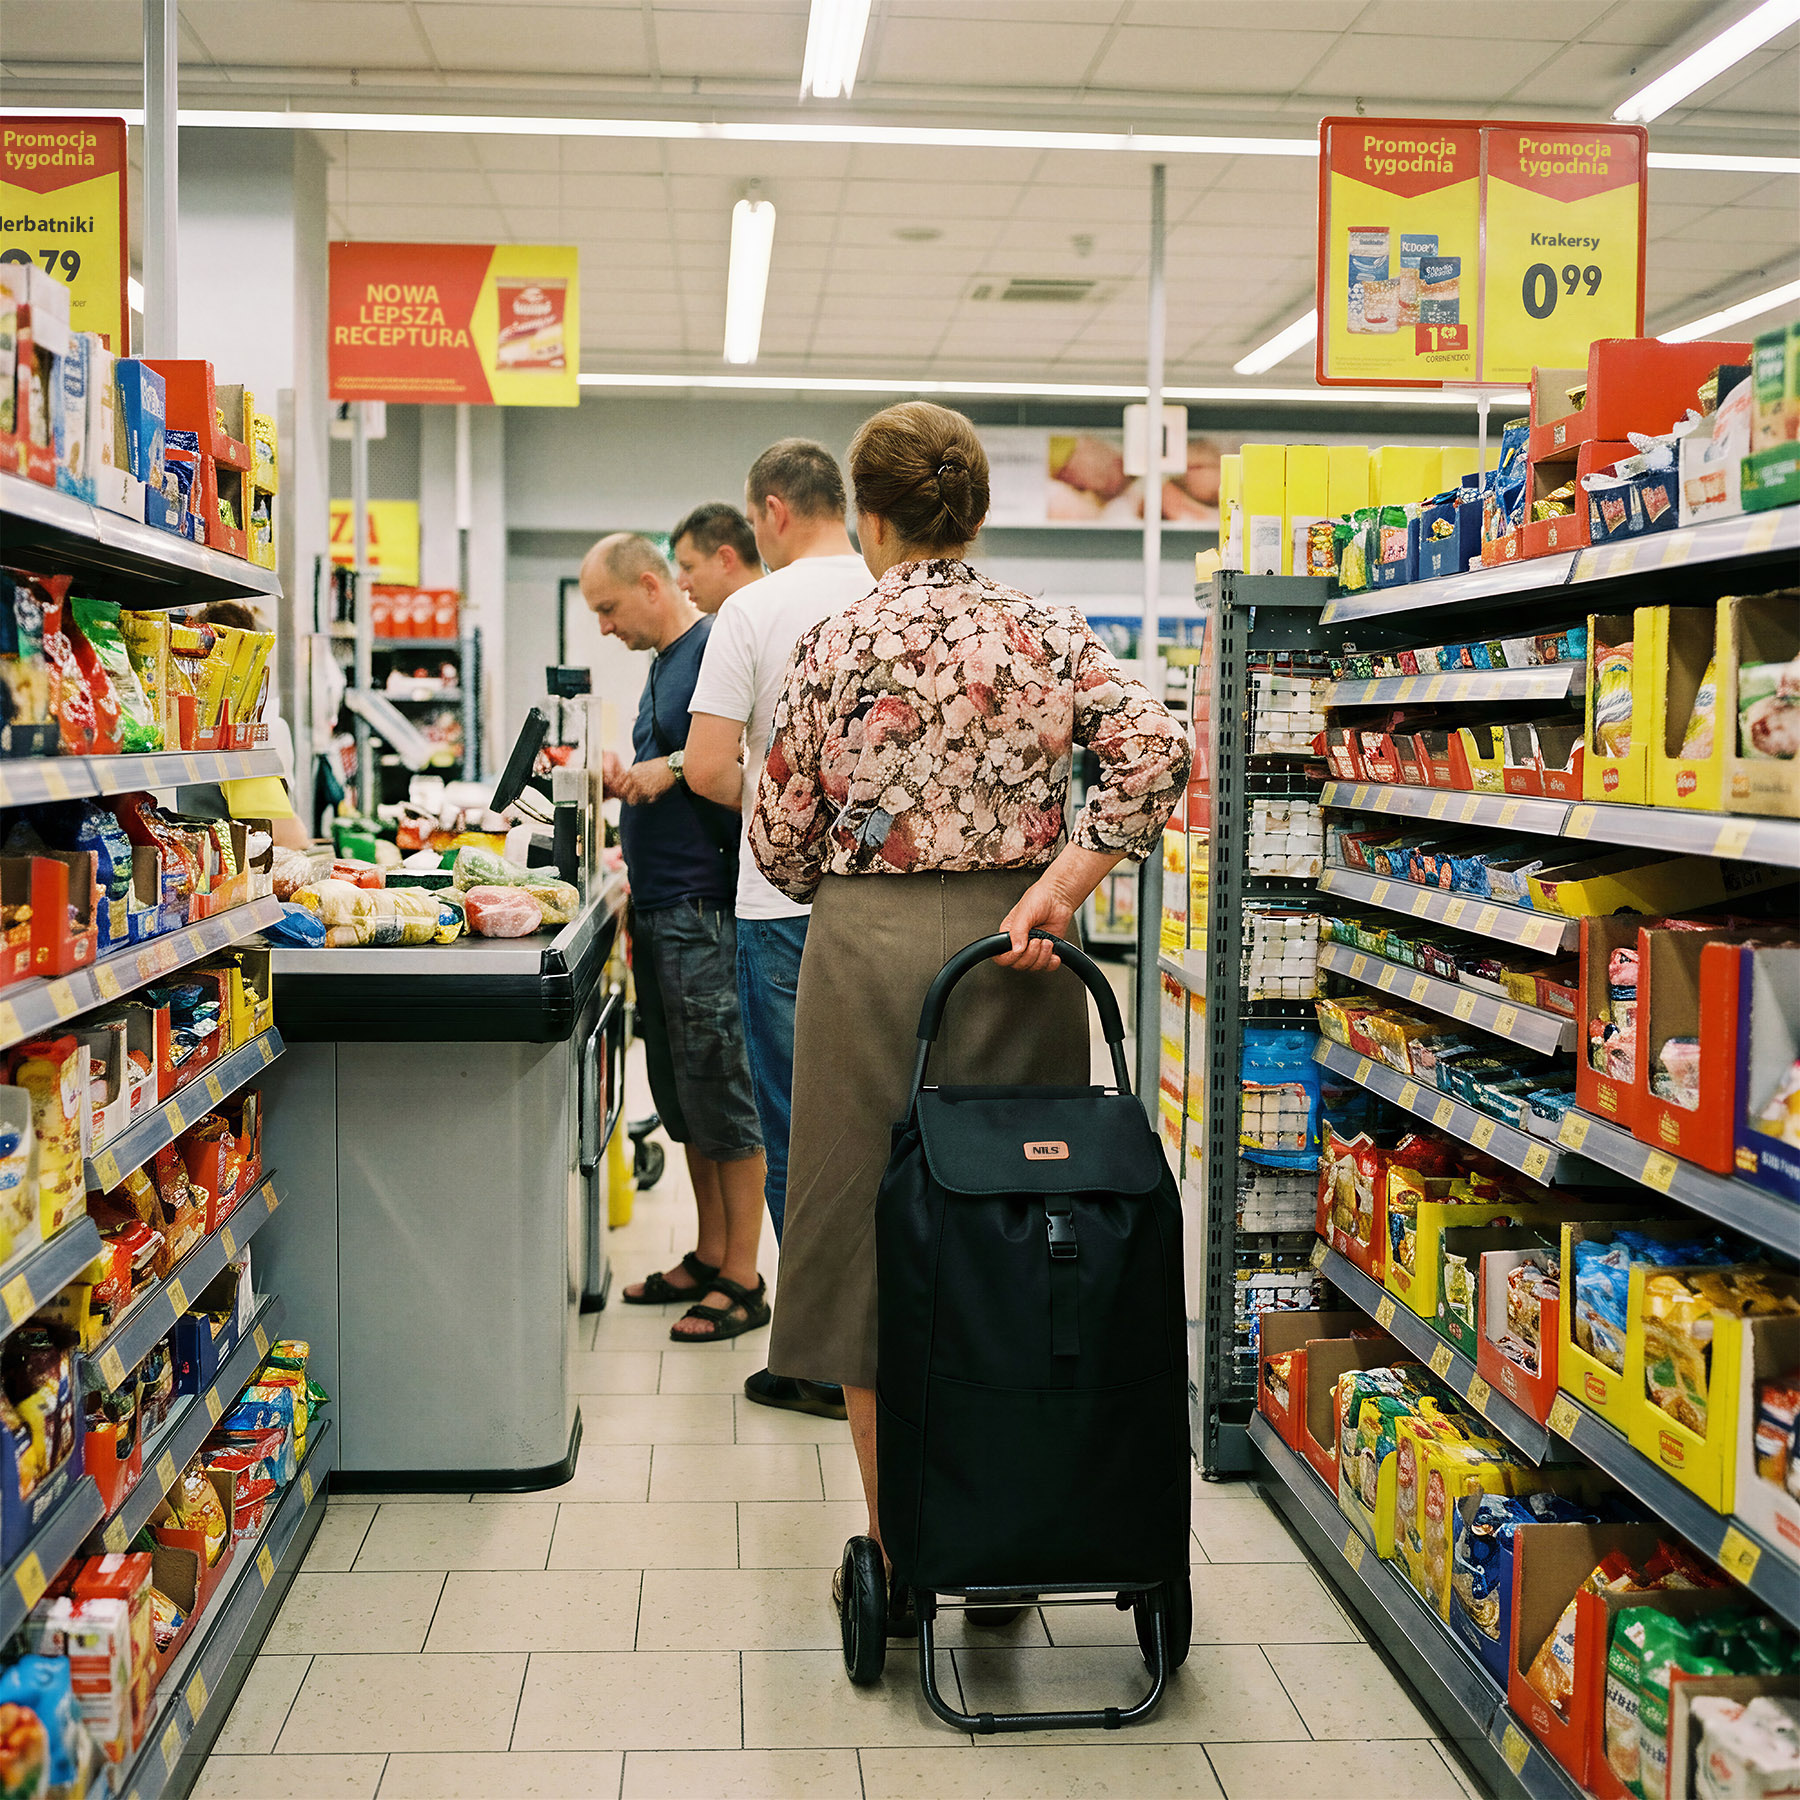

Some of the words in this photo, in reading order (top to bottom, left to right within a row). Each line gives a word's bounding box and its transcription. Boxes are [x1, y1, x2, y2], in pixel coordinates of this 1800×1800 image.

[3, 130, 97, 151] Promocja
[1363, 135, 1457, 159] Promocja
[1518, 137, 1612, 161] Promocja
[5, 149, 96, 170] tygodnia
[1364, 154, 1454, 176] tygodnia
[1519, 156, 1609, 178] tygodnia
[0, 215, 94, 233] erbatniki
[1530, 232, 1601, 252] Krakersy
[366, 283, 440, 305] NOWA
[359, 304, 446, 326] LEPSZA
[334, 325, 470, 349] RECEPTURA
[1032, 1146, 1060, 1155] NILS
